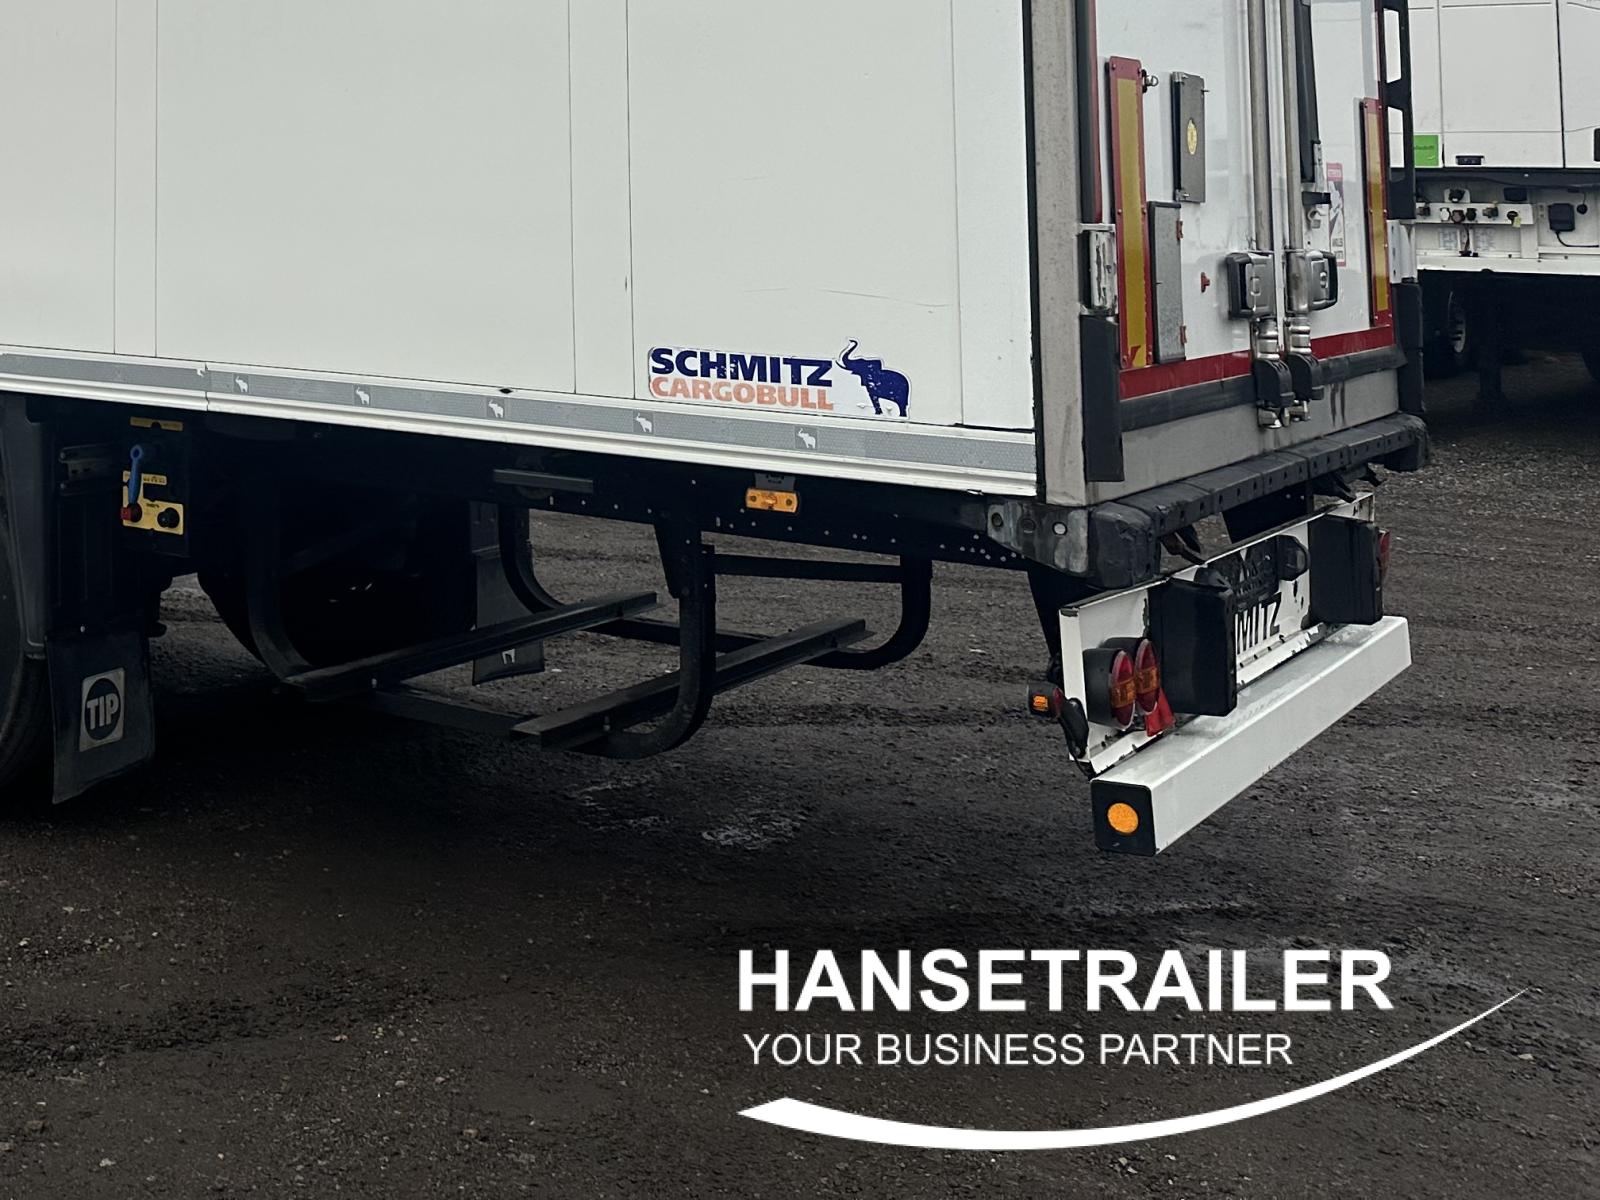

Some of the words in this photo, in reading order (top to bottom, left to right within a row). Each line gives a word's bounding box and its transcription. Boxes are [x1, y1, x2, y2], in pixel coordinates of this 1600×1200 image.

[650, 348, 833, 388] SCHMITZ
[650, 376, 834, 411] CARGOBULL
[1236, 591, 1282, 655] MITZ
[86, 692, 120, 730] TIP
